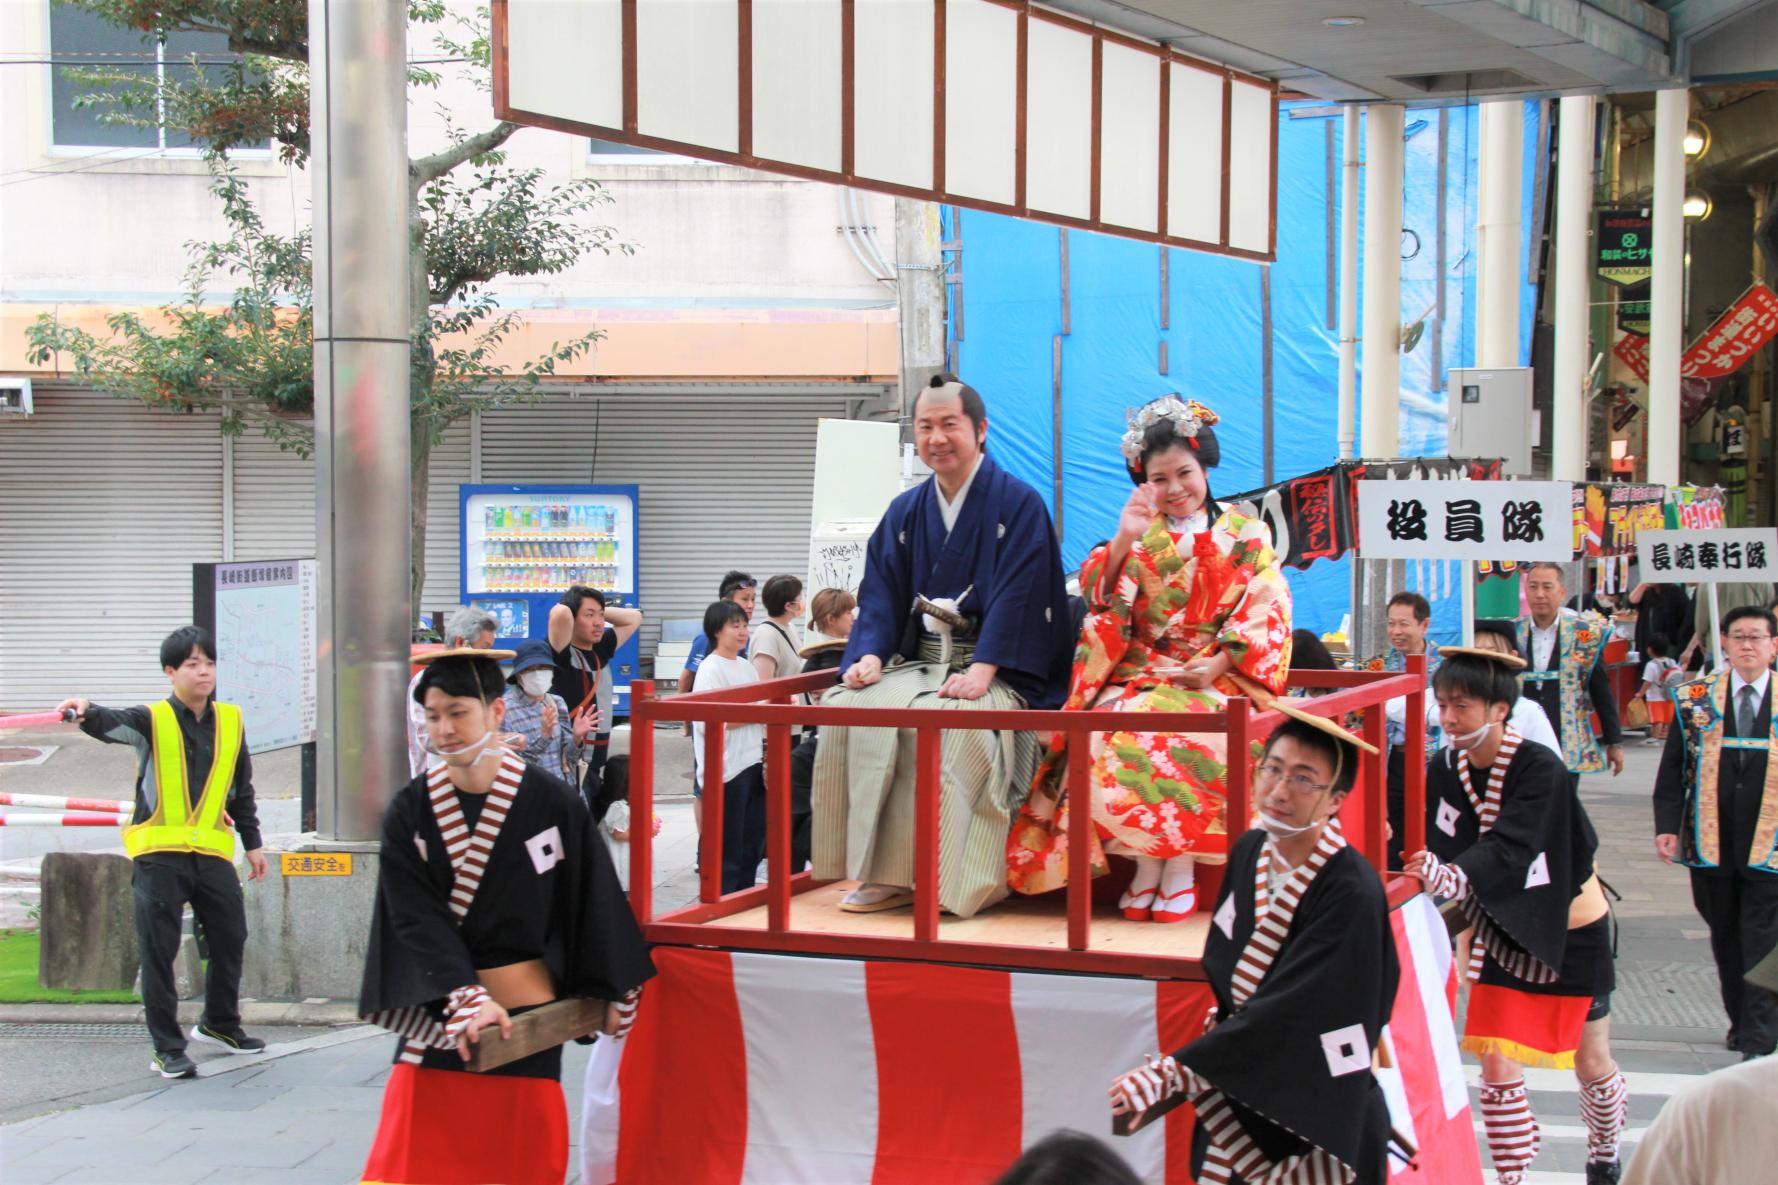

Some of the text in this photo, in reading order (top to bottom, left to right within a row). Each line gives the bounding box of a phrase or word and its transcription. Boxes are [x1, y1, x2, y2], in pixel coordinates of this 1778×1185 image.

[1603, 268, 1651, 276] HONMACH
[1386, 498, 1545, 543] 役員隊
[1650, 541, 1768, 571] 長崎奉行隊
